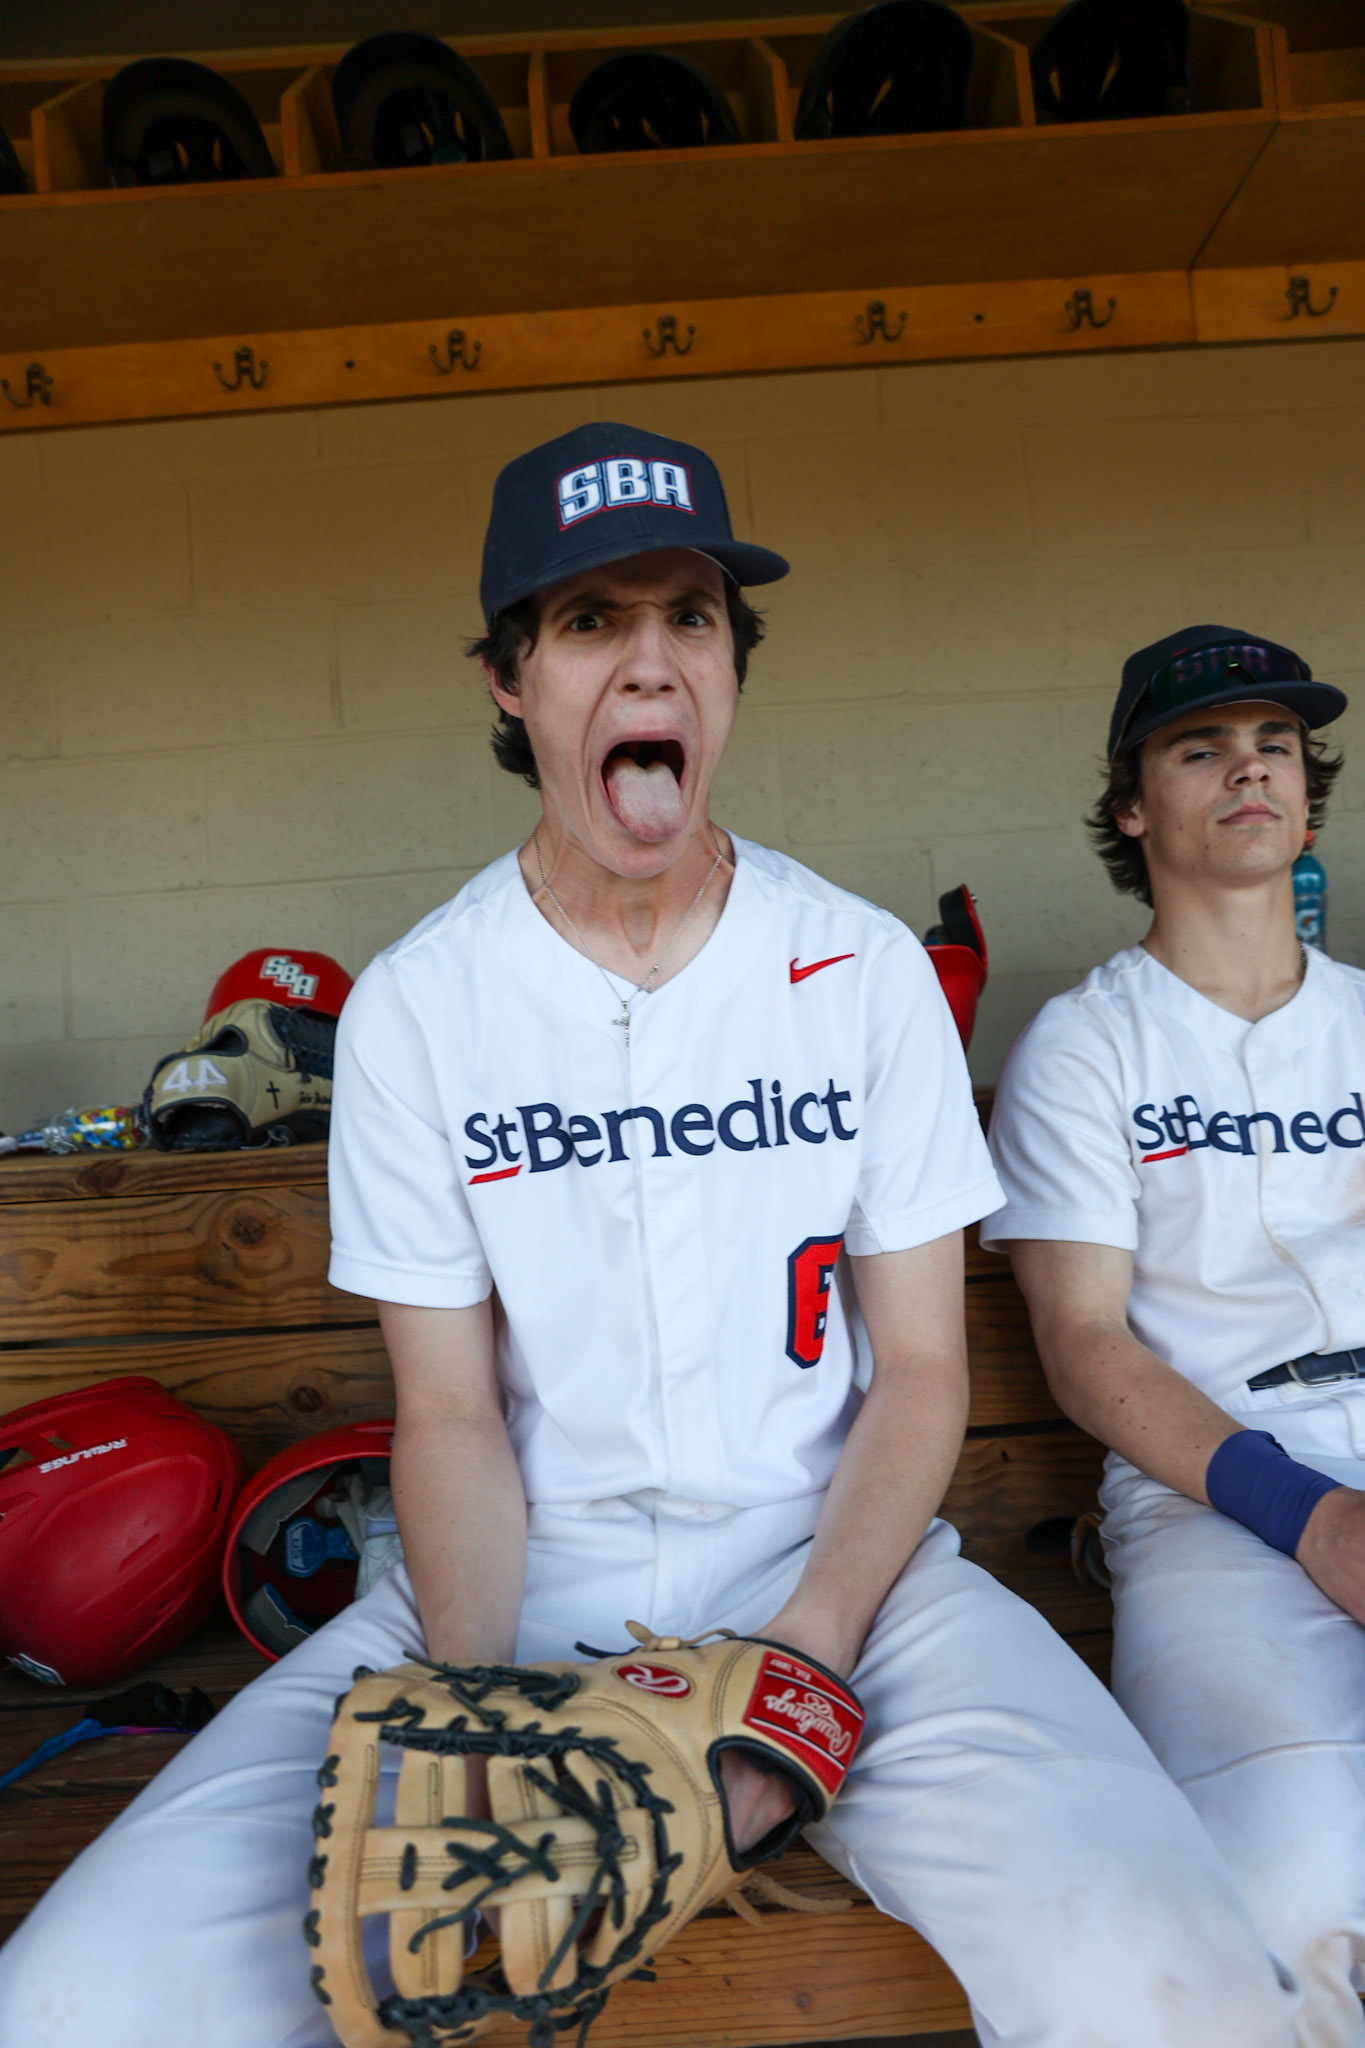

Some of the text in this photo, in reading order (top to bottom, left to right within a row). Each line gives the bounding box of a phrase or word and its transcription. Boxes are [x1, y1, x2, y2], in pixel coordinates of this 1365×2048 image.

[555, 455, 695, 531] SBA
[259, 955, 319, 1000] SBA
[39, 1437, 128, 1474] RAWLINGS
[763, 1688, 852, 1756] Rawlings
